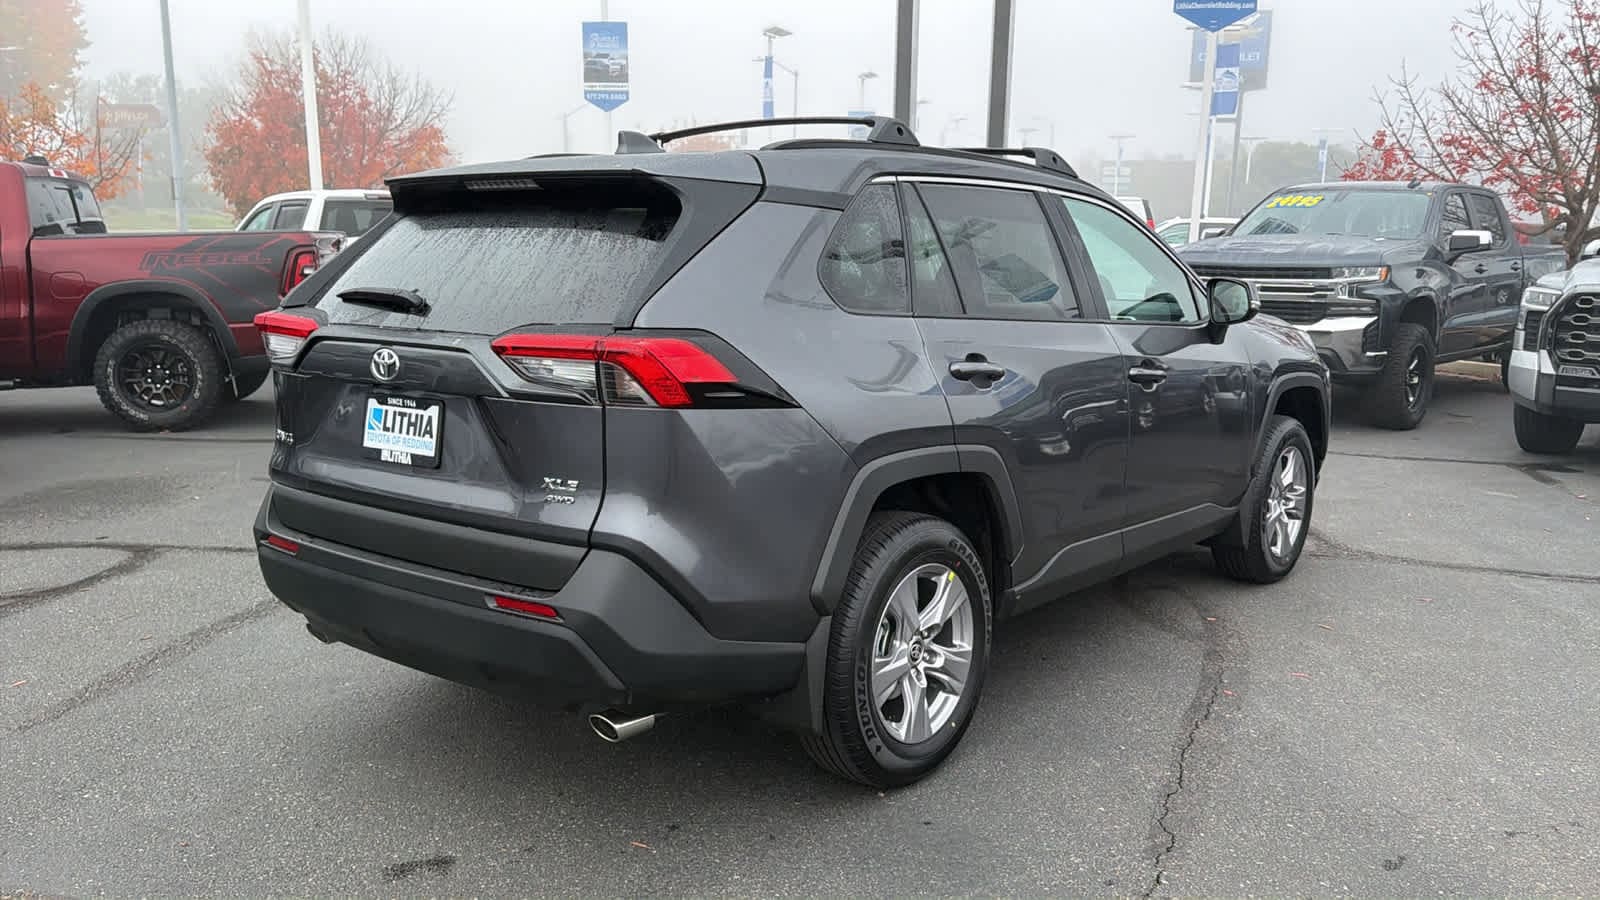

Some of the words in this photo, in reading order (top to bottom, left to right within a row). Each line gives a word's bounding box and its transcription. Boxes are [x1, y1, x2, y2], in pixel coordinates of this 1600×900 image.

[387, 397, 403, 406] SINCE
[383, 409, 433, 438] LITHIA
[367, 431, 391, 443] TOYOTA
[392, 435, 401, 445] OF
[402, 437, 433, 451] REDDING
[390, 449, 412, 465] LITHIA
[541, 477, 579, 491] XLE
[543, 494, 575, 504] AWD
[857, 654, 877, 742] DUNLO
